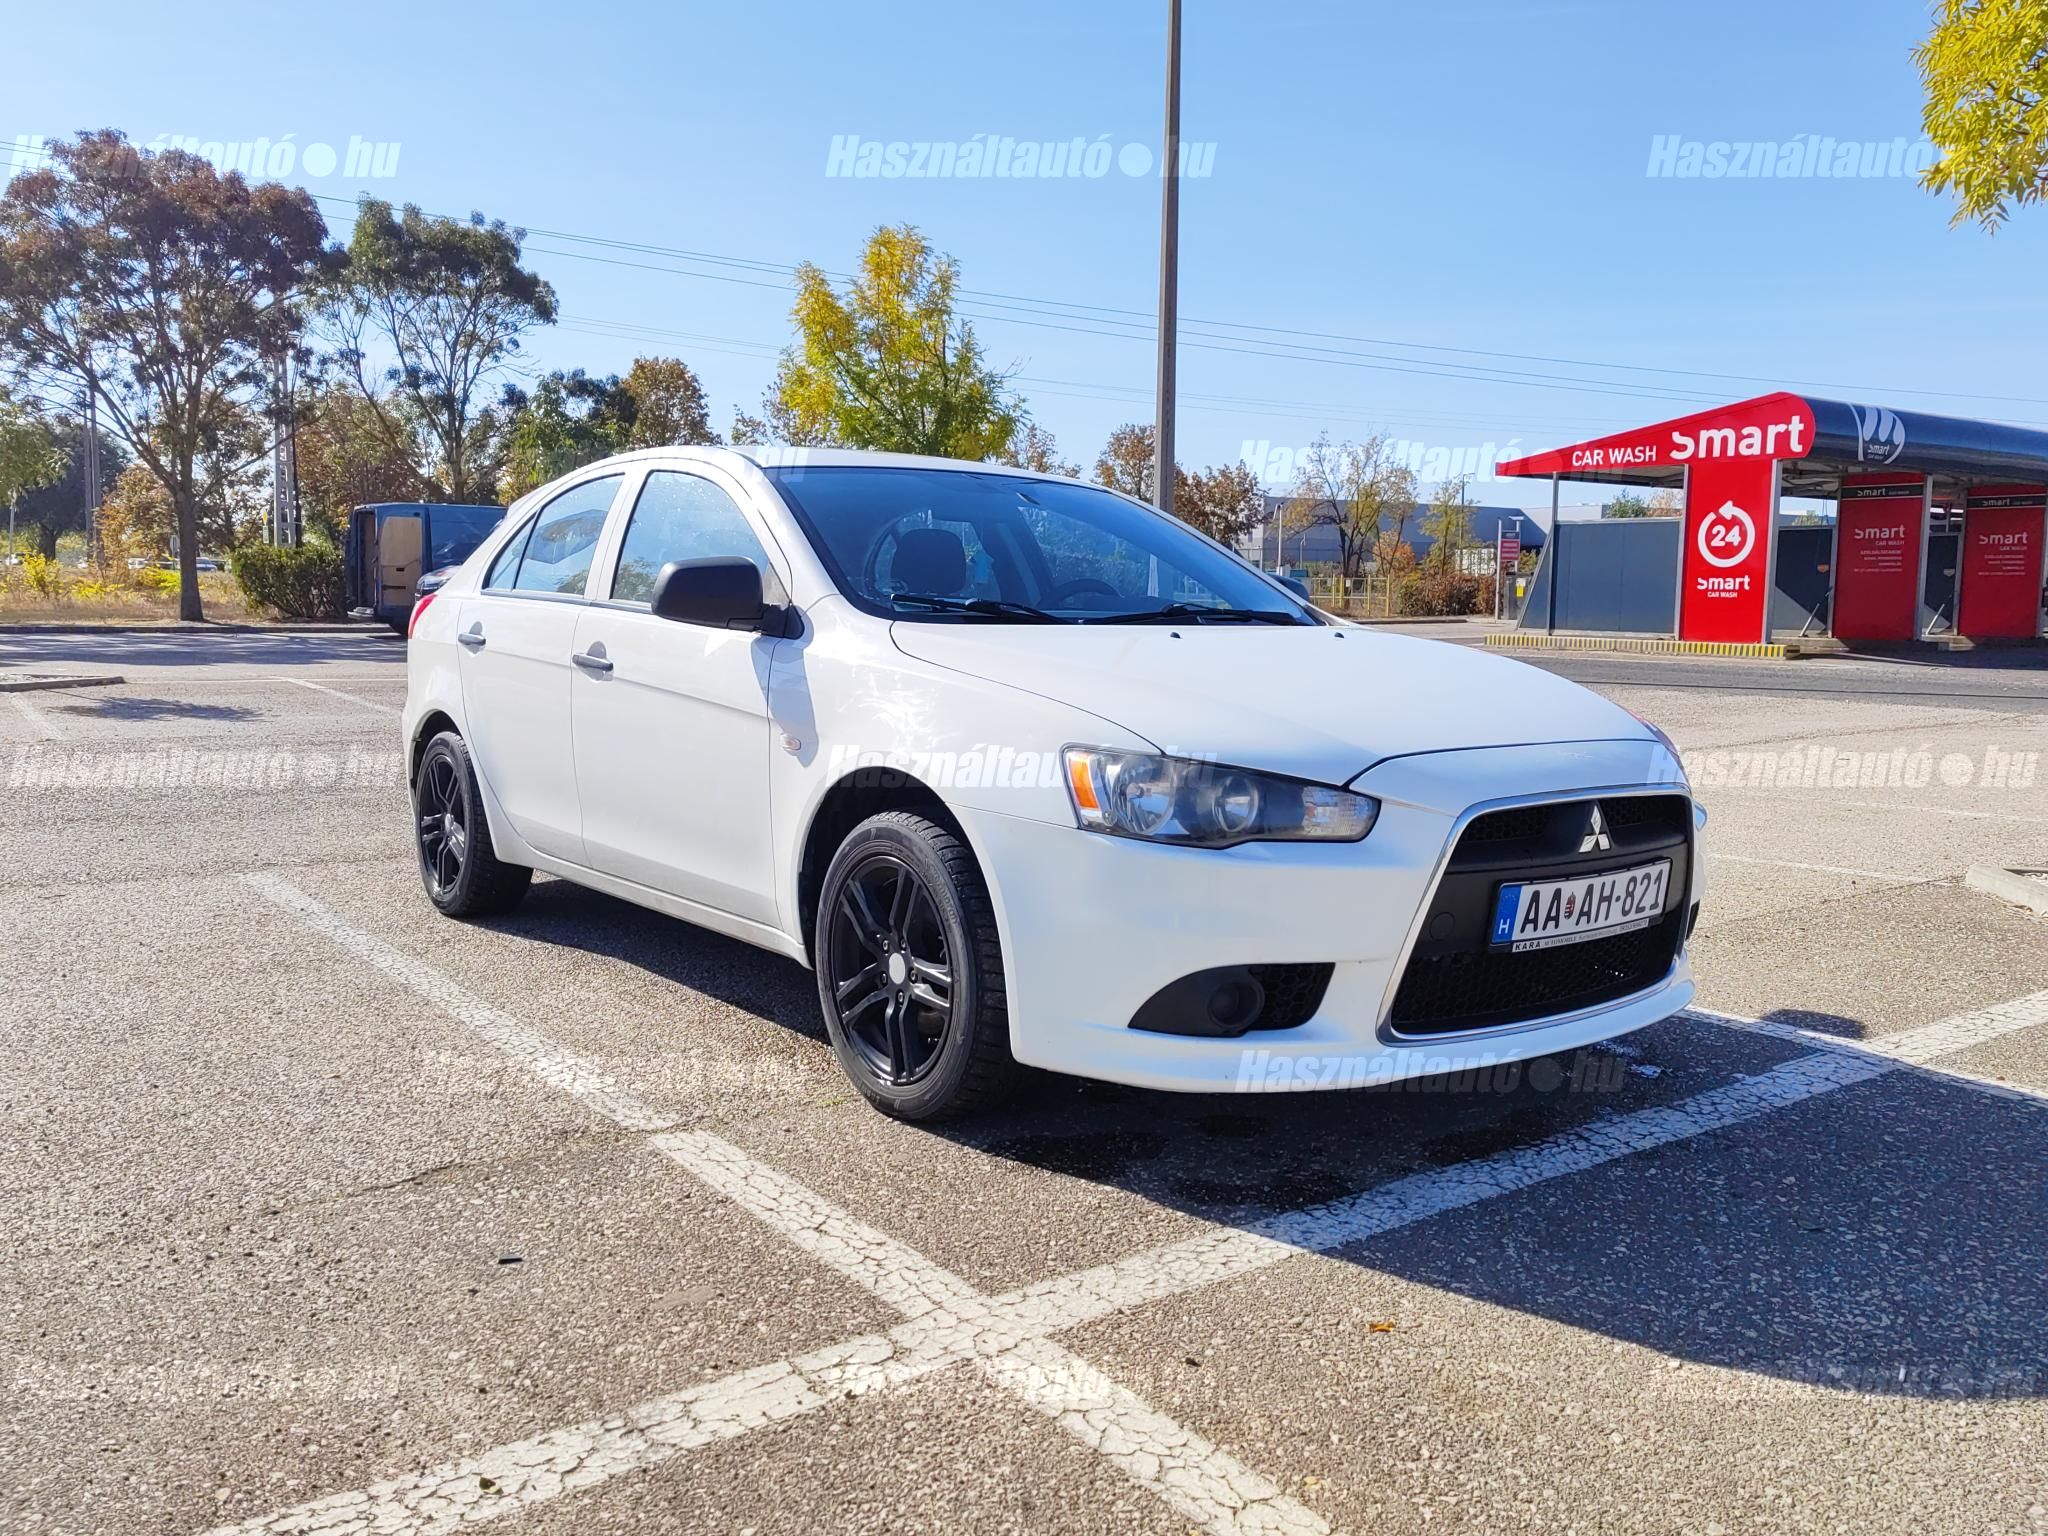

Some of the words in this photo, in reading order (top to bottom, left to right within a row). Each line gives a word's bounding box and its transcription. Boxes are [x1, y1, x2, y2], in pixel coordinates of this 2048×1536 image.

[1572, 450, 1603, 467] CAR
[1608, 445, 1657, 464] WASH
[1669, 415, 1804, 460] Smart
[1868, 444, 1890, 455] Smart
[1857, 487, 1886, 497] Smart
[1711, 525, 1741, 547] 24
[1854, 524, 1906, 539] Smart
[1978, 531, 2028, 545] Smart
[1696, 575, 1751, 591] Smart
[1497, 919, 1511, 935] H
[1515, 940, 1541, 951] KARA
